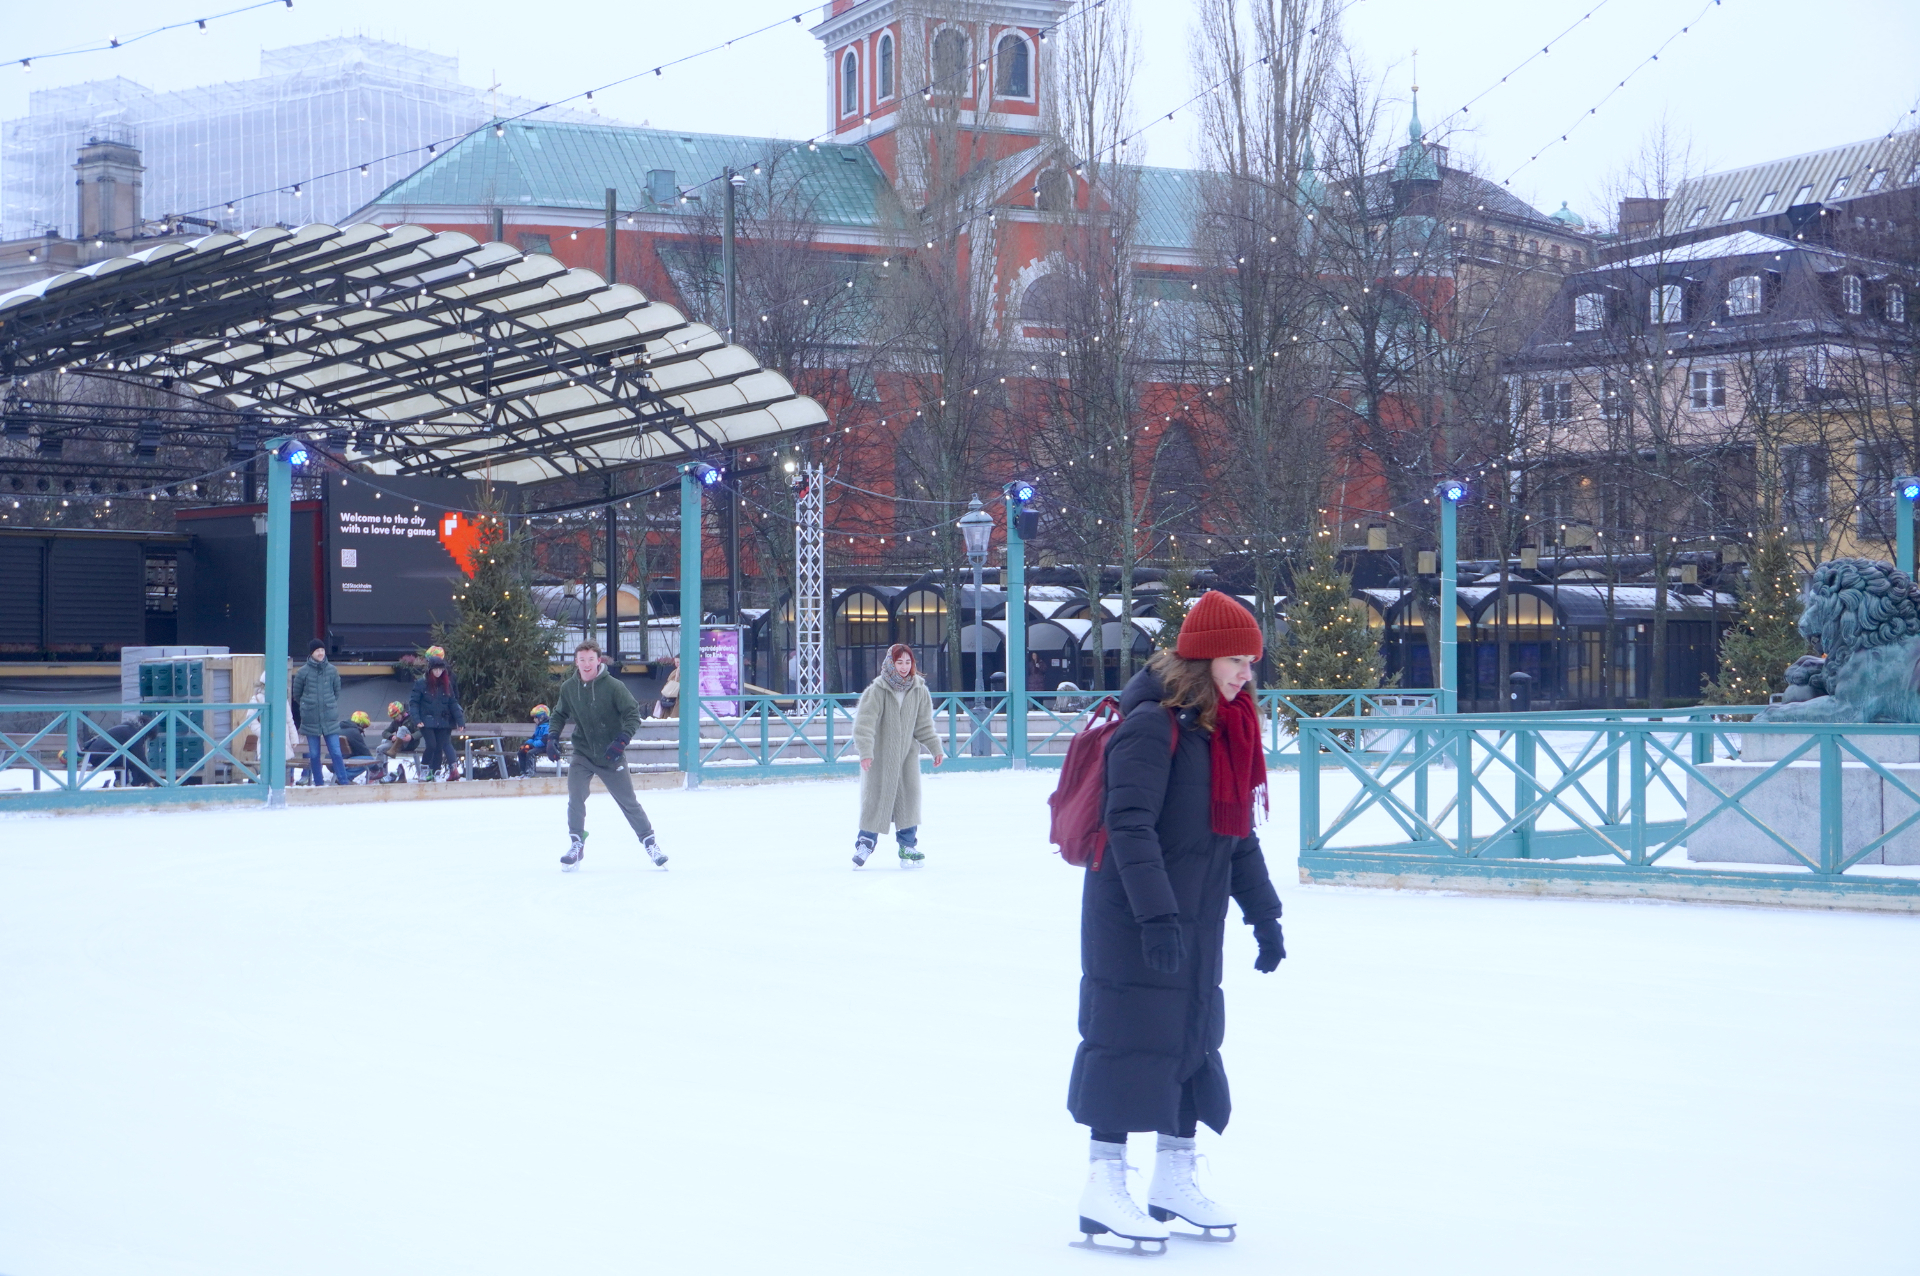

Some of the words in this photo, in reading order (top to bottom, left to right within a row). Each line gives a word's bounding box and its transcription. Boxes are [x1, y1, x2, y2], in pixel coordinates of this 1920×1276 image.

[340, 512, 381, 523] Welcome
[383, 515, 392, 524] to
[394, 514, 409, 524] the
[410, 515, 426, 527] city
[340, 524, 361, 533] with
[371, 524, 390, 534] love
[392, 525, 406, 535] for
[407, 528, 436, 538] games
